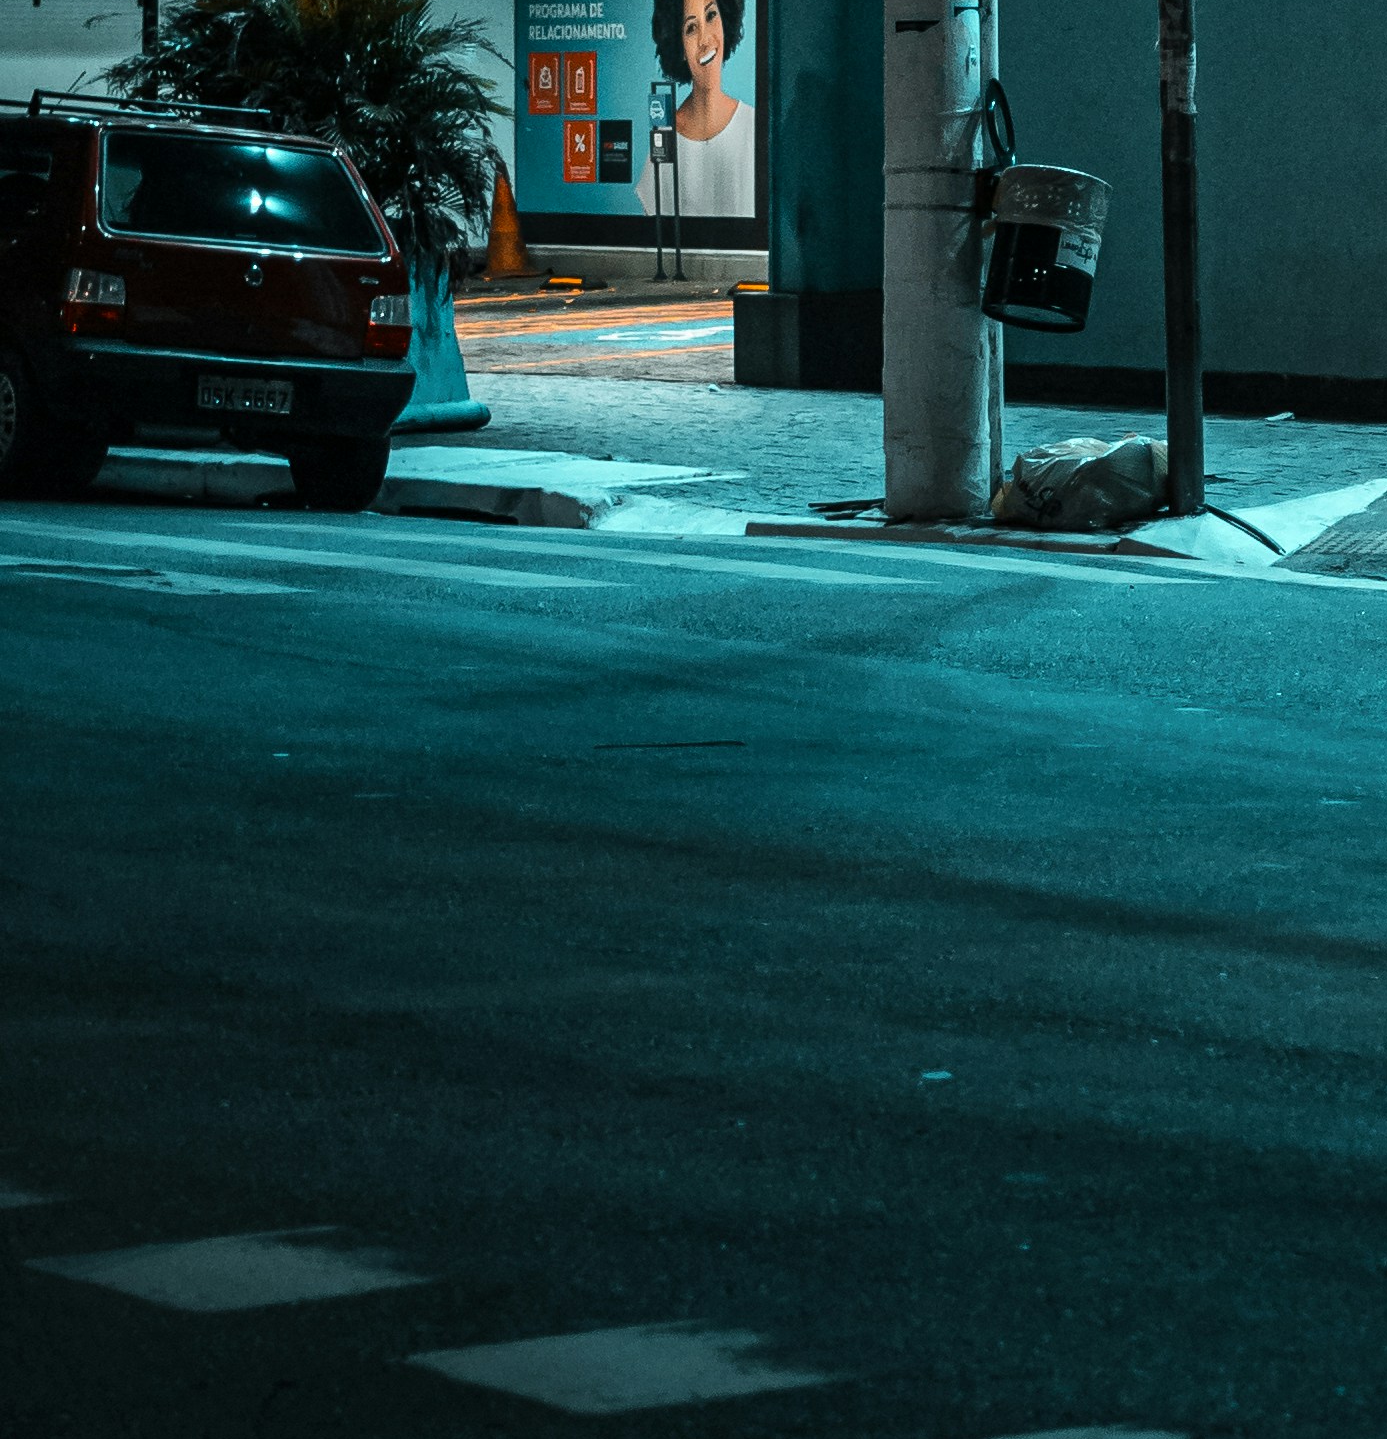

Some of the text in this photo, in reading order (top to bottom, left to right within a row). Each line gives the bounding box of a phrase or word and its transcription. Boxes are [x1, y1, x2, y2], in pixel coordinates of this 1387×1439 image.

[528, 2, 605, 19] PROGRAMA DE
[527, 23, 628, 41] RELACIONAMENTO.
